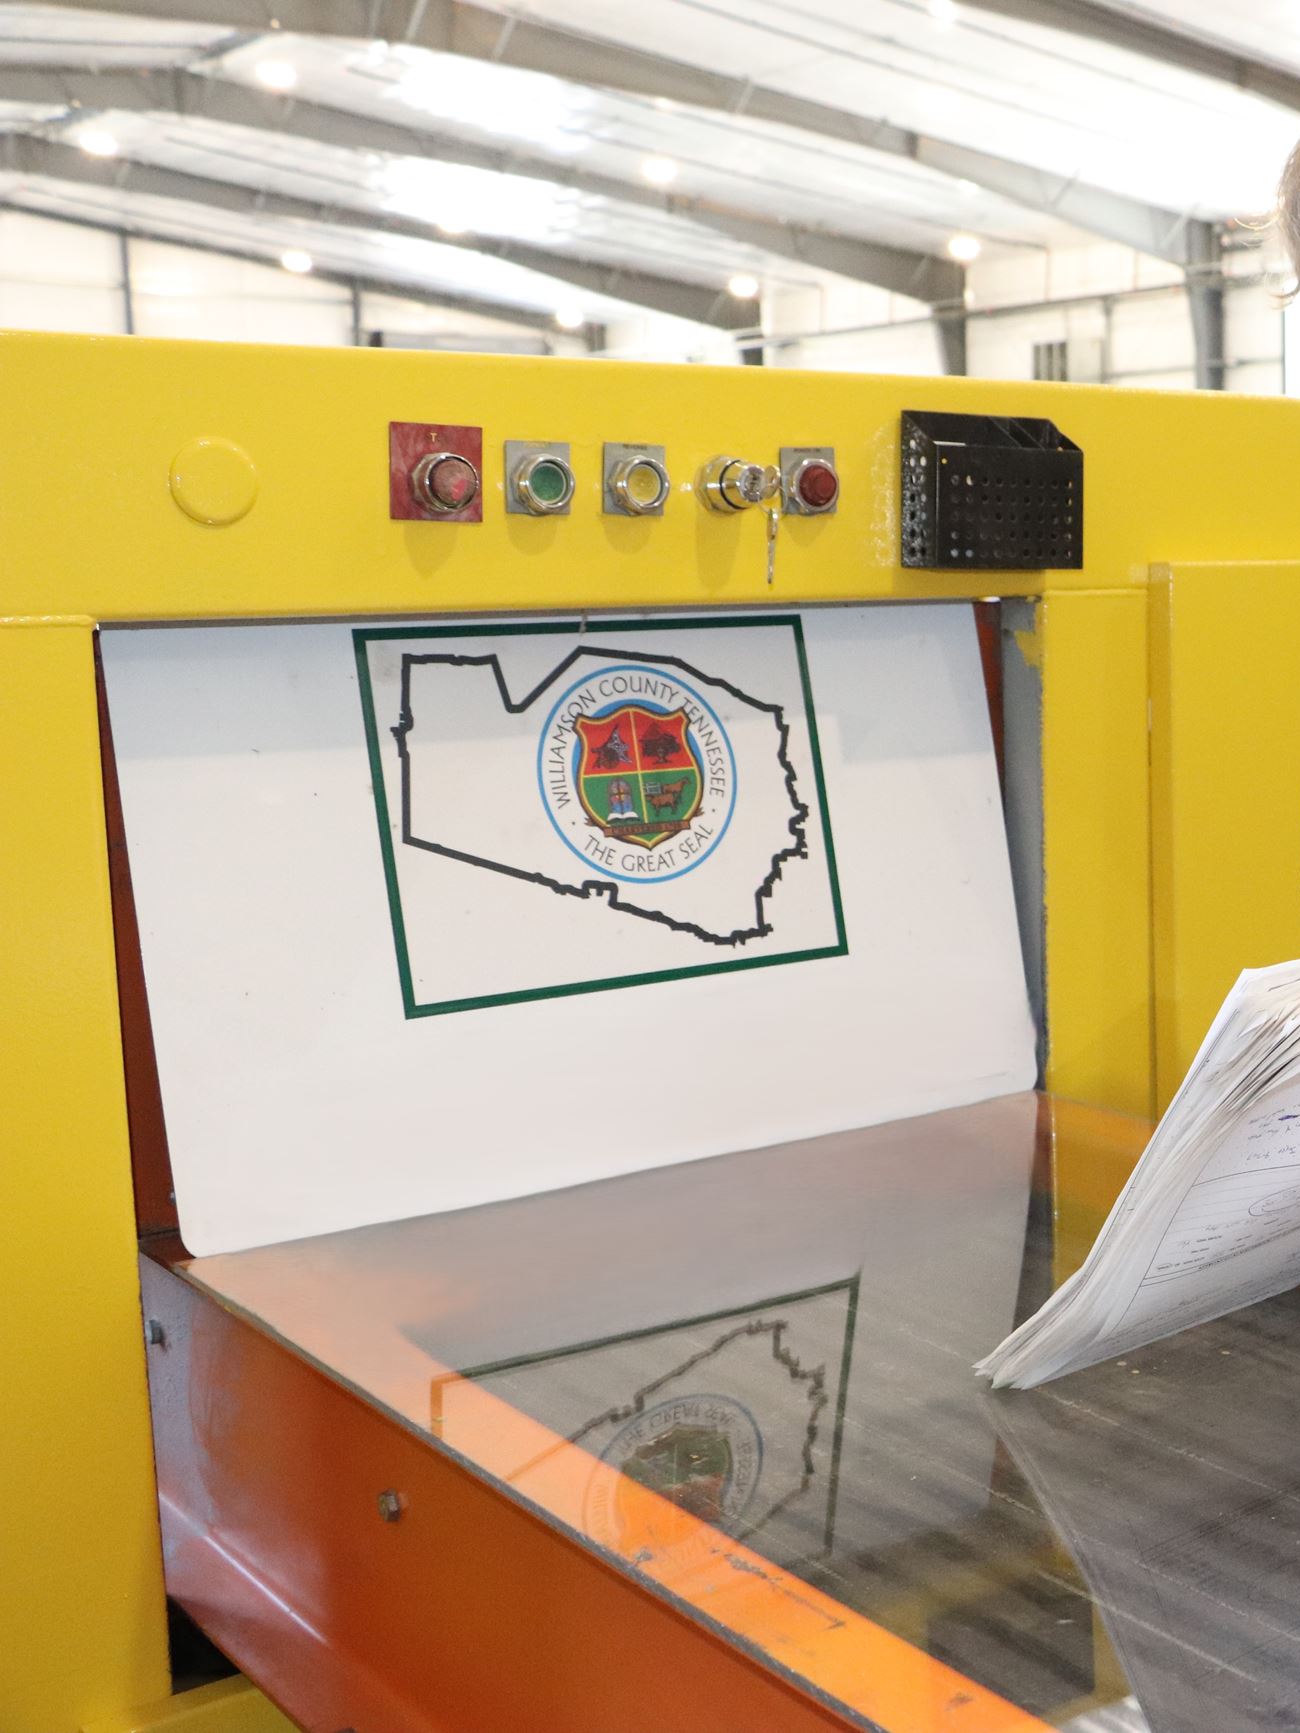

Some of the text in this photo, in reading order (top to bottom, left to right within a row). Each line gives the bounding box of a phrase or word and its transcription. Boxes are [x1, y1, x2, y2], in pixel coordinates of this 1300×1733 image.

[549, 676, 725, 809] WILLIAMSON COUNTY TENNESSEE
[583, 834, 616, 866] THE
[621, 848, 677, 872] GREAT
[681, 825, 713, 859] SEAL
